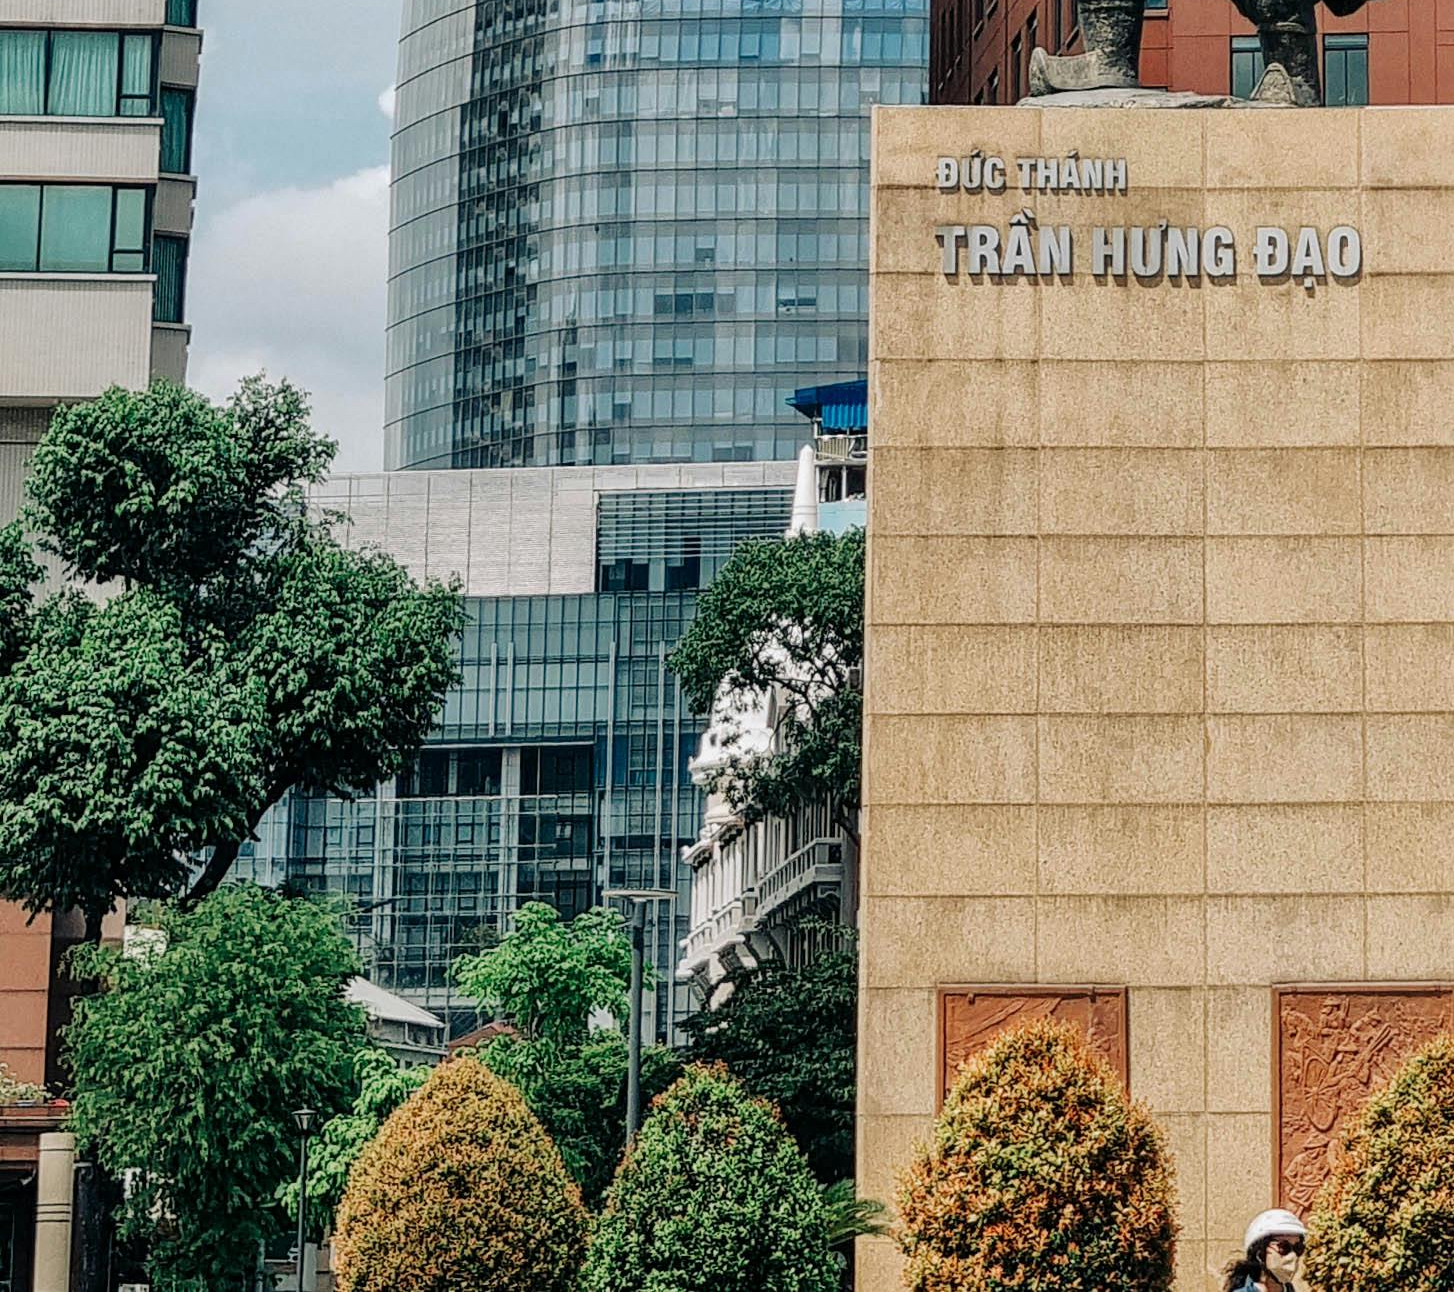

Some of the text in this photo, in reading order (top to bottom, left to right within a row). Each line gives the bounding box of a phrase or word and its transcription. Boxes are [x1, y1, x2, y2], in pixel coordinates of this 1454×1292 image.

[935, 149, 1128, 193] ĐỨC THÁNH
[935, 207, 1363, 293] TRẦN HƯNG ĐẠO
